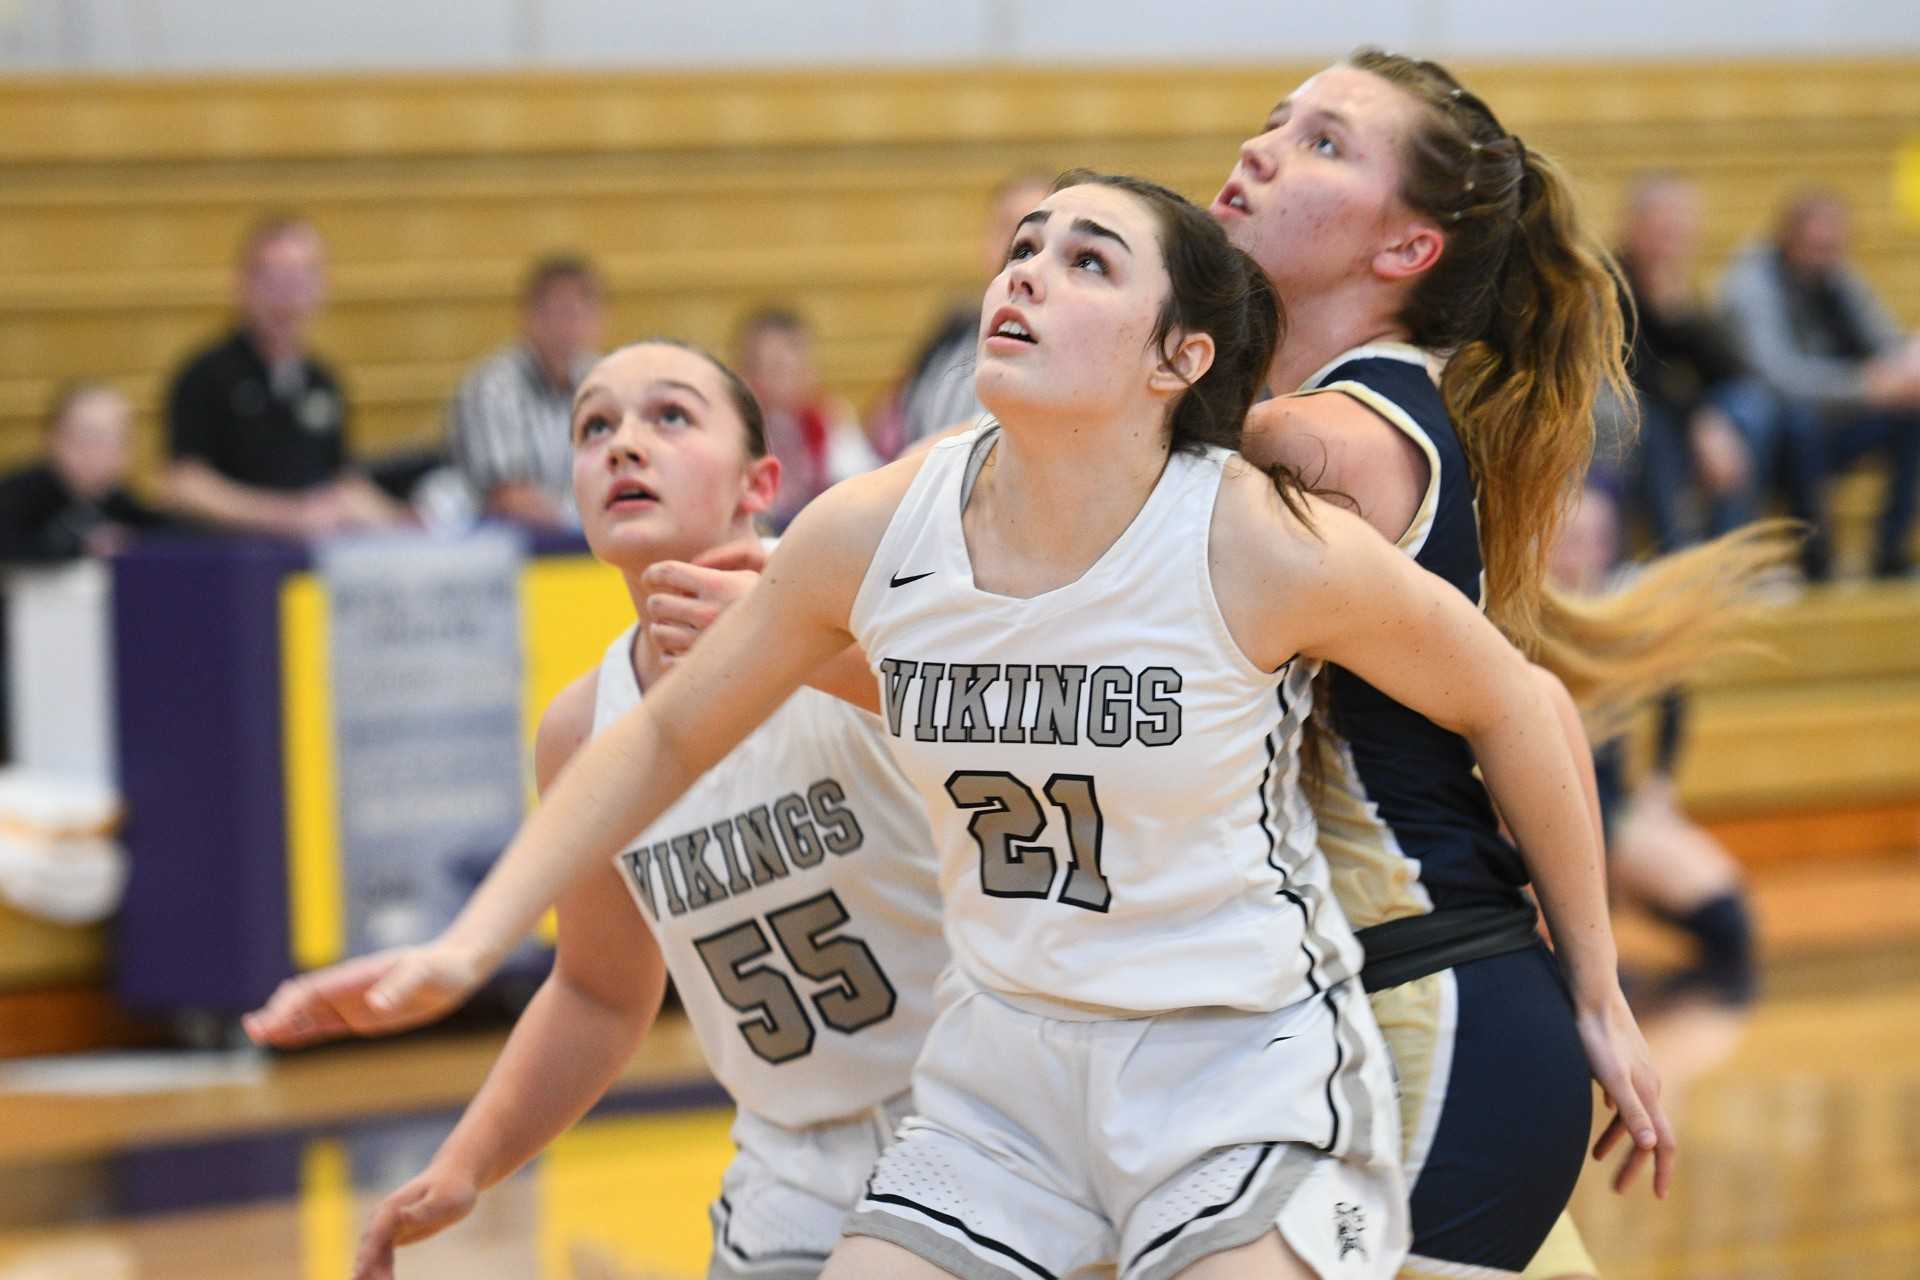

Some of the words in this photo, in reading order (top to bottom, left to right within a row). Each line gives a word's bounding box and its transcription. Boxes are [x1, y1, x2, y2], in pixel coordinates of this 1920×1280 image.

[880, 658, 1183, 747] VIKINGS
[621, 778, 864, 922] VIKINGS
[944, 770, 1112, 913] 21
[692, 888, 898, 1066] 55
